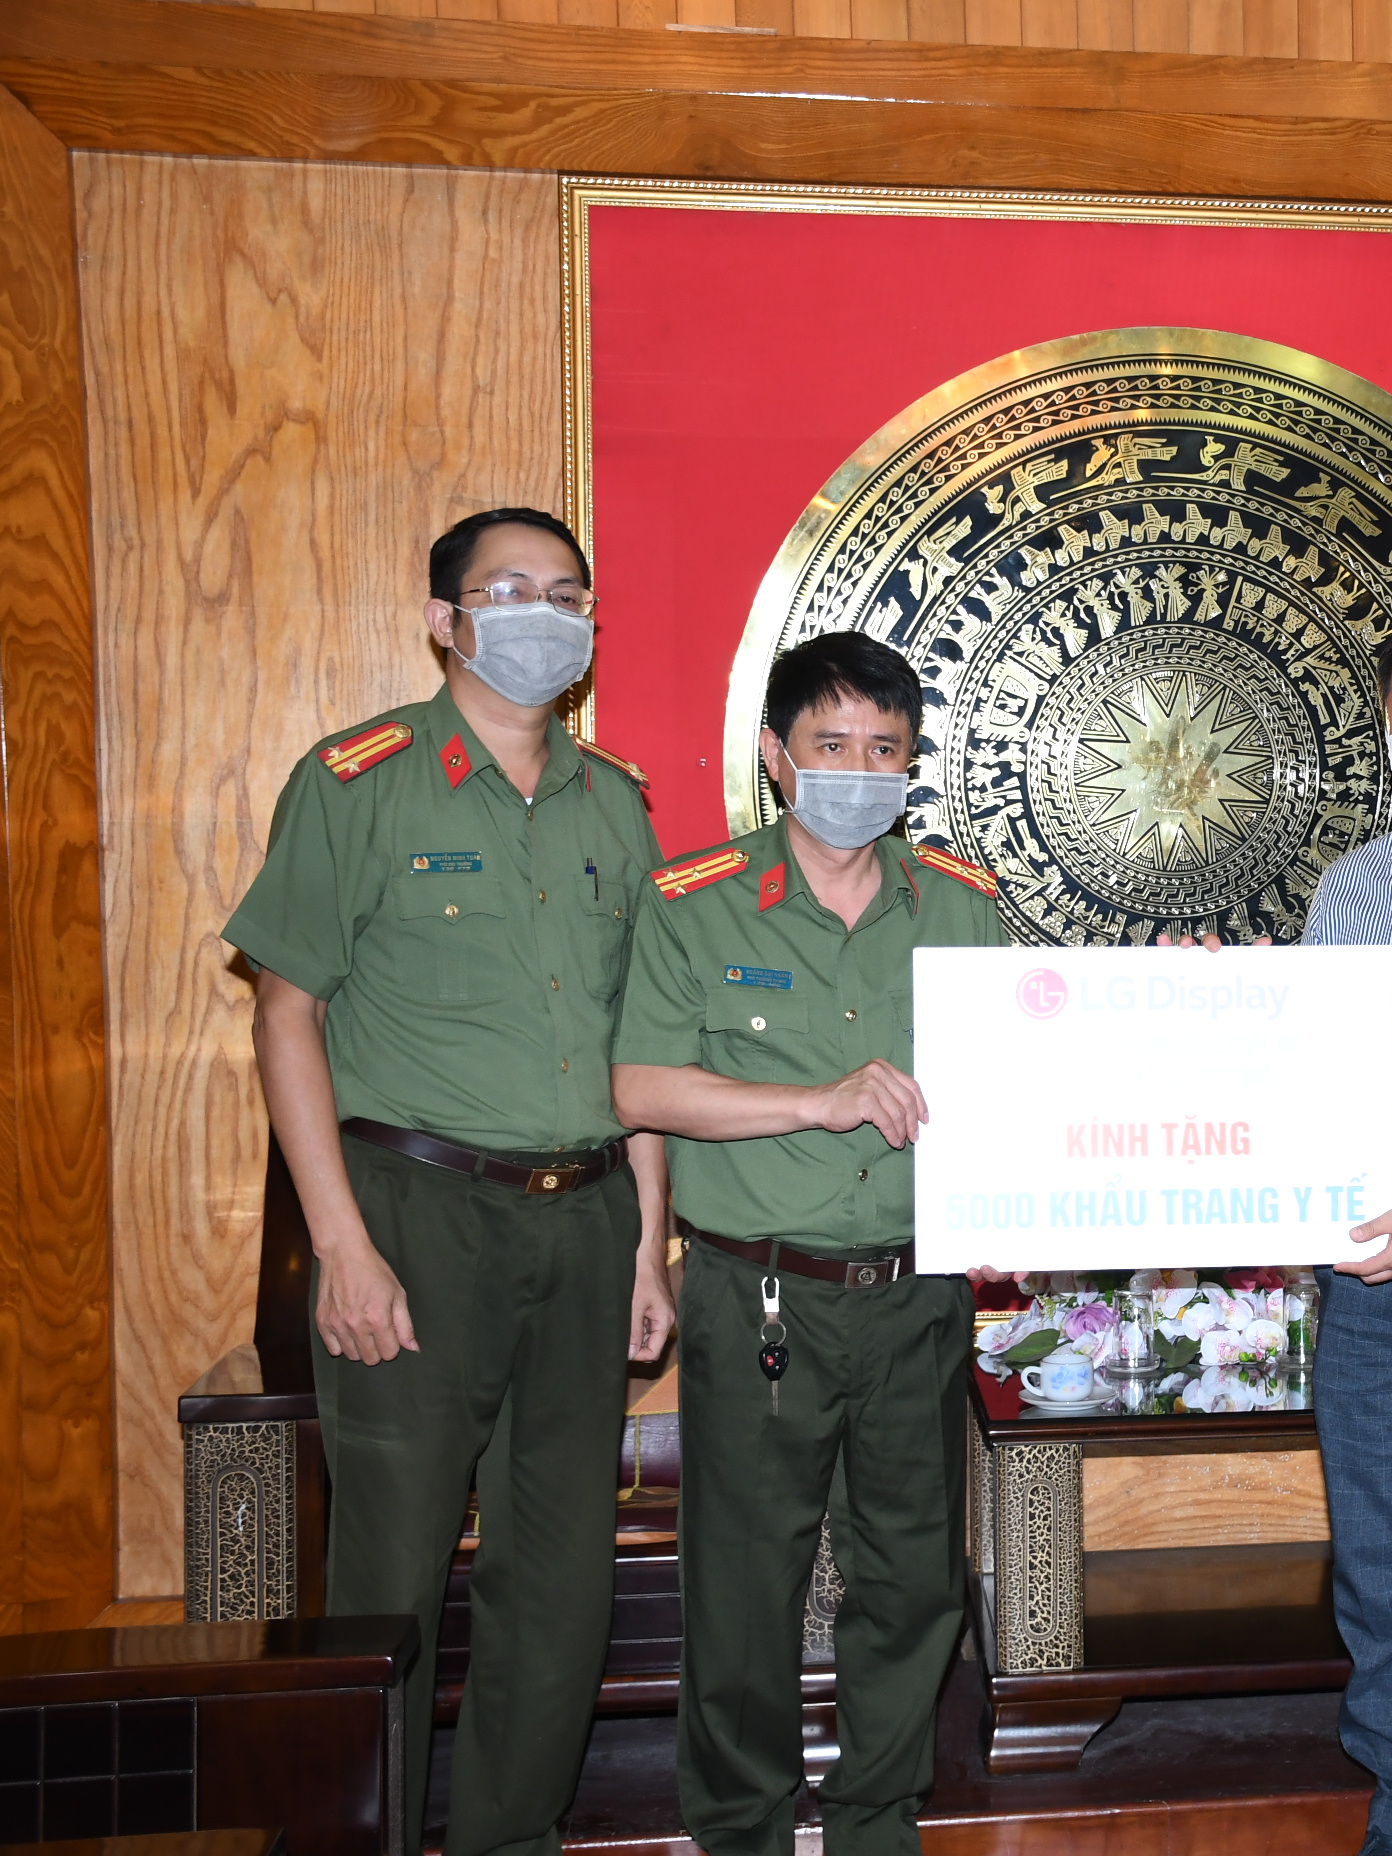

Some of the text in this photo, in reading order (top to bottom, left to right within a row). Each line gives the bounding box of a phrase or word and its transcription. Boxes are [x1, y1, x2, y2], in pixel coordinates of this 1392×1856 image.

[1080, 976, 1136, 1011] LG
[1148, 975, 1290, 1020] Display
[1067, 1115, 1251, 1164] KÍNH TẶNG
[946, 1173, 1367, 1230] 5000 KHẨU TRANG Y TẾ
